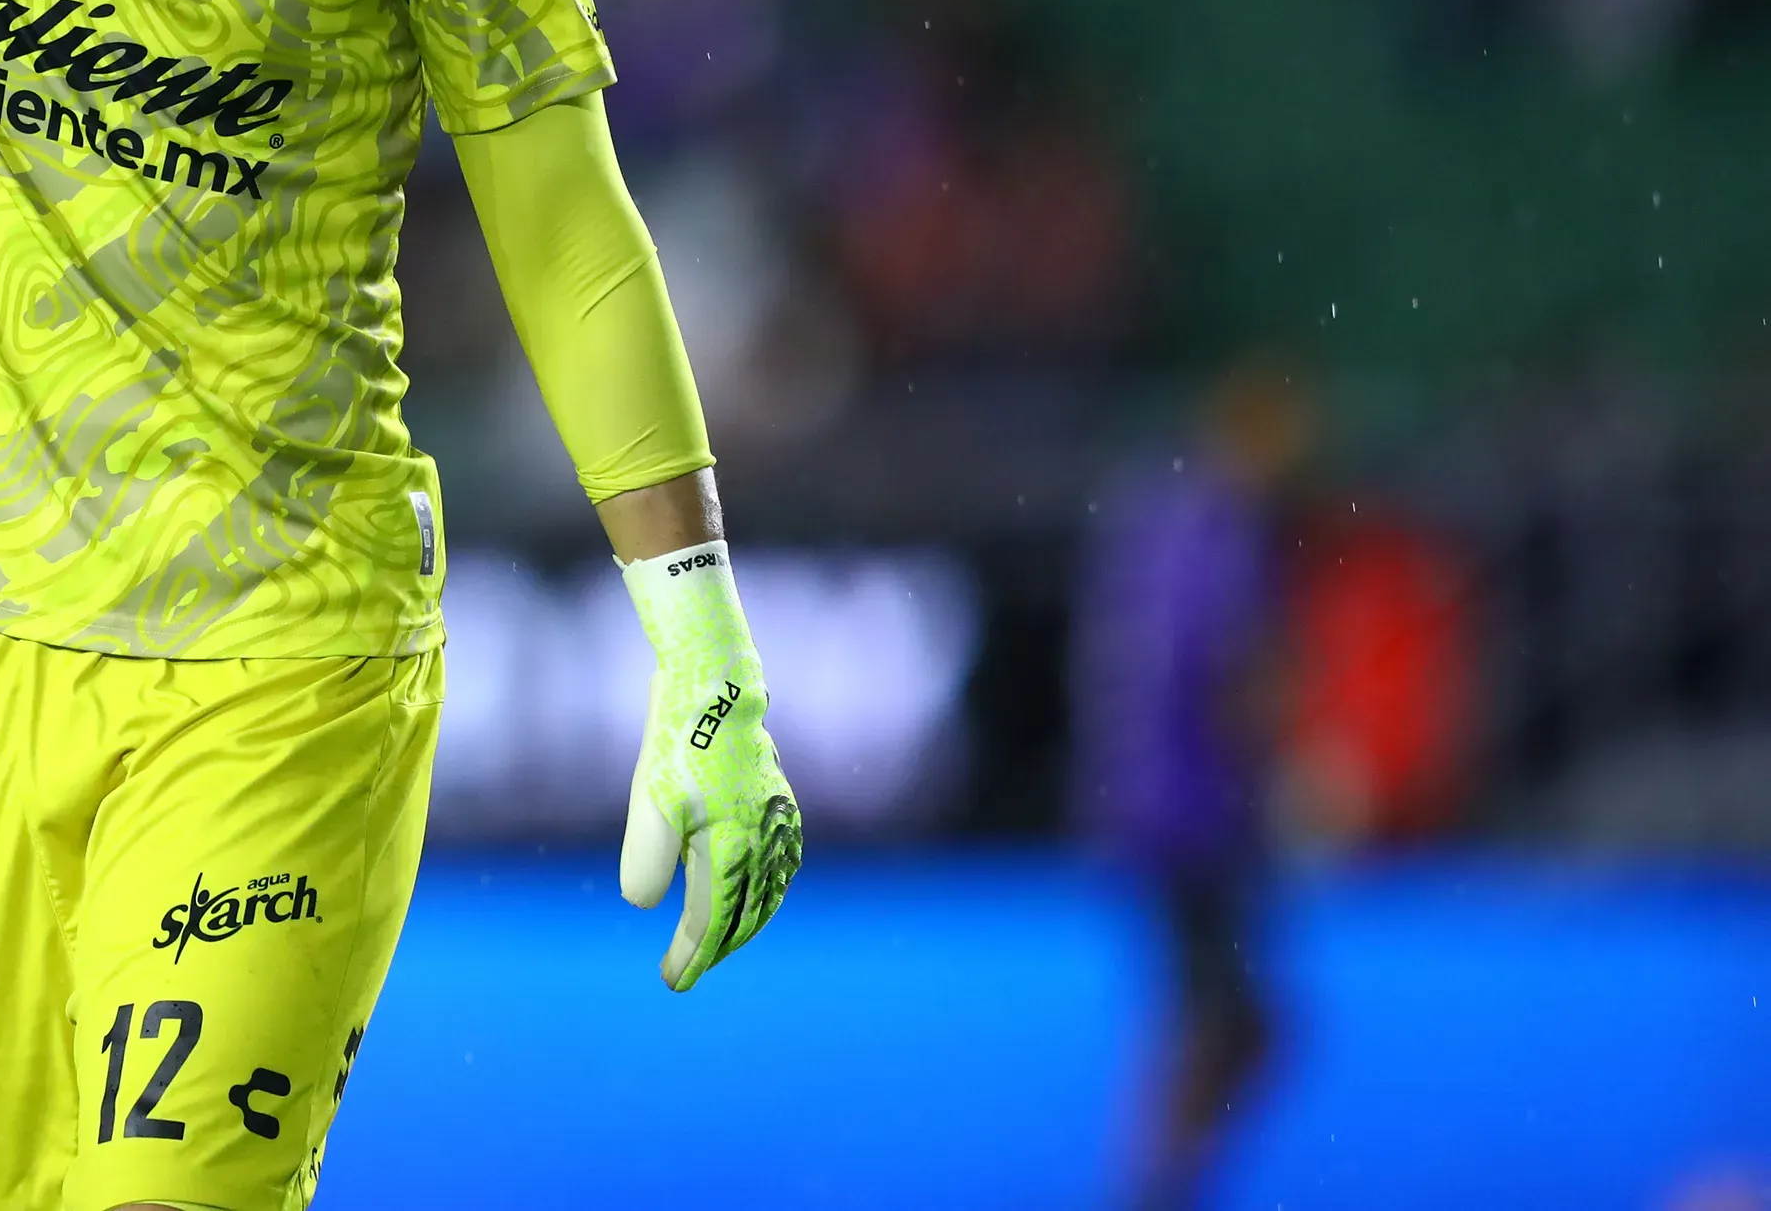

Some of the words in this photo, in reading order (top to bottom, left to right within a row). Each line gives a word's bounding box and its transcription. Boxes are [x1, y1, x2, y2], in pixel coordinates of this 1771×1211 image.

[689, 679, 742, 751] PRED
[246, 872, 291, 891] agua
[97, 999, 204, 1145] 12
